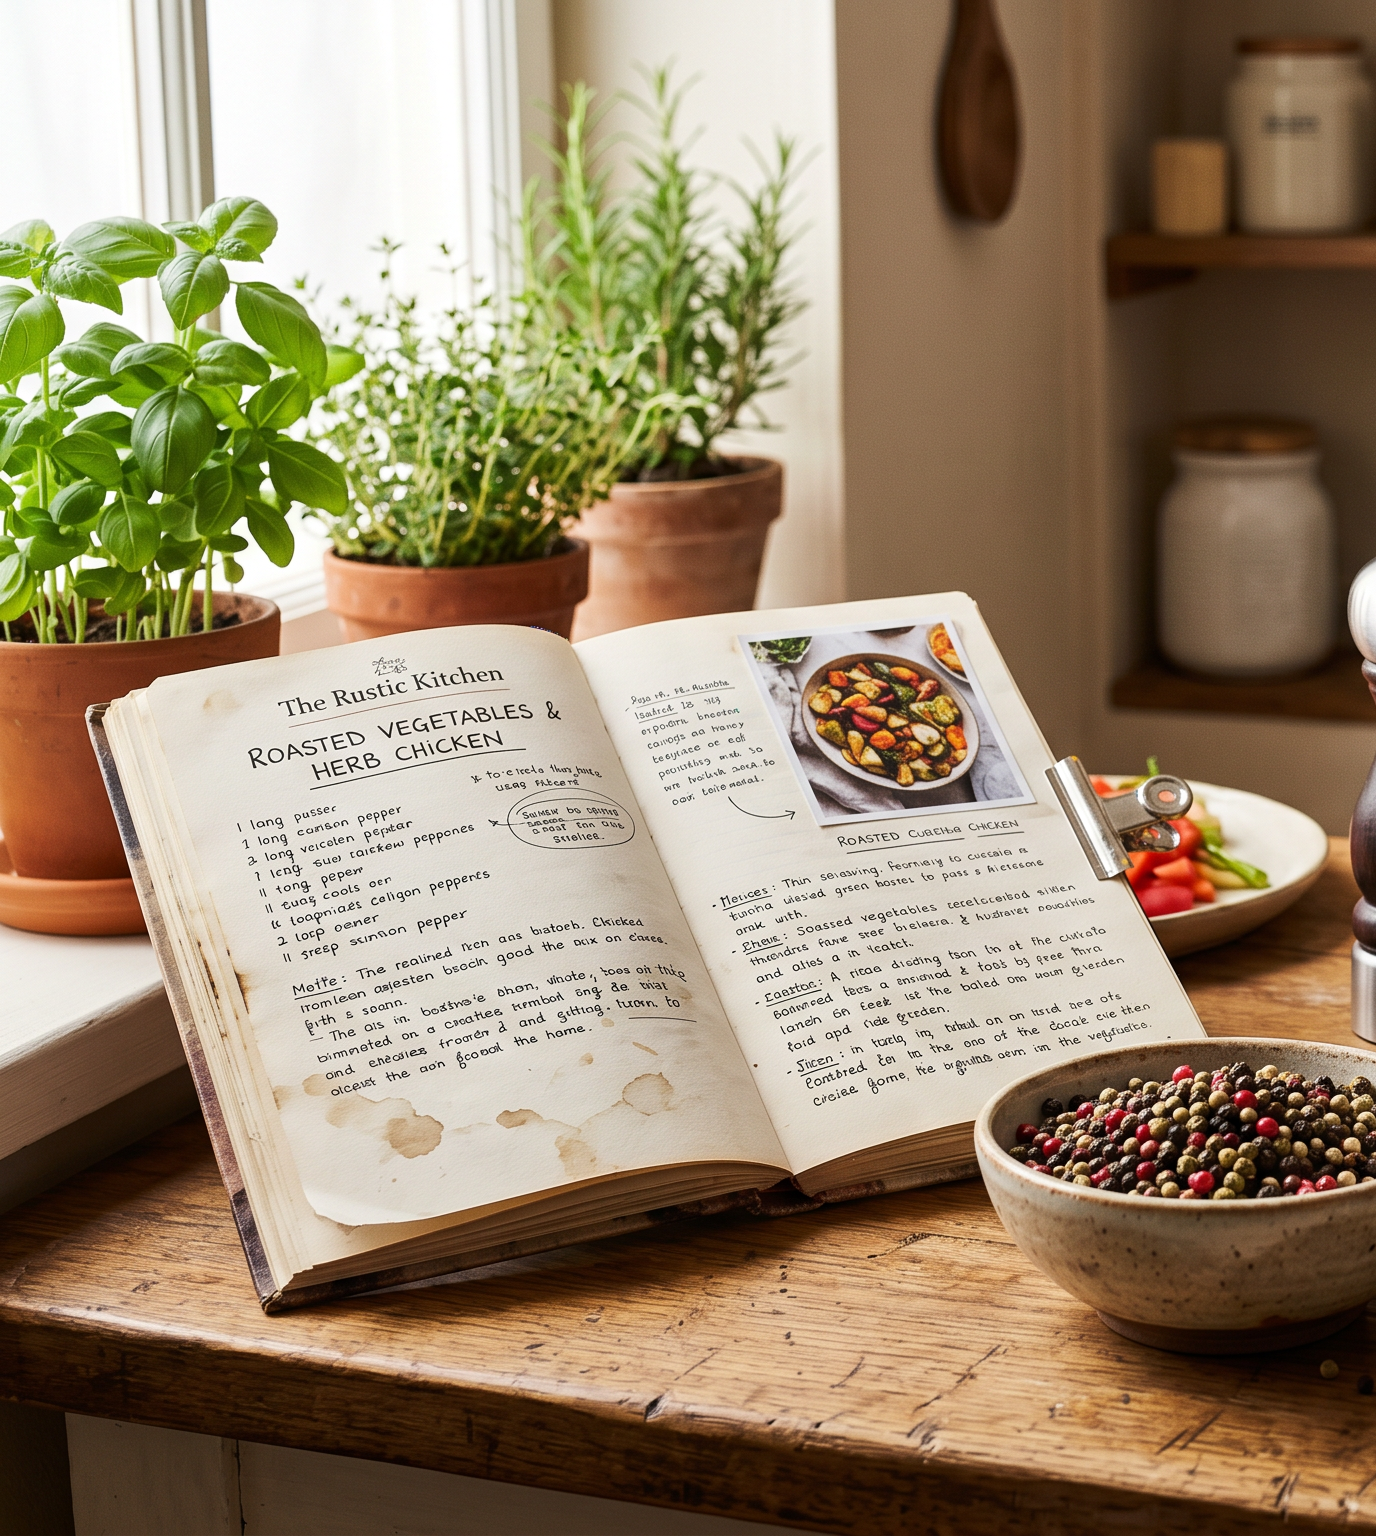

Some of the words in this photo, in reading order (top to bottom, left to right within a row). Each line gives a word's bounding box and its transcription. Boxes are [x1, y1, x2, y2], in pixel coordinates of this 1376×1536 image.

[277, 697, 328, 719] The
[330, 678, 409, 708] Rustic
[410, 666, 505, 692] Kitchen
[247, 730, 366, 770] ROASTED
[376, 703, 534, 739] VEGETABLES
[545, 700, 562, 721] &
[310, 752, 382, 781] HERB
[257, 833, 289, 847] long
[357, 806, 402, 828] pepper
[836, 831, 900, 848] ROASTED
[967, 819, 1020, 832] CHICKEN
[264, 849, 295, 865] long
[780, 877, 812, 889] Thin
[941, 869, 969, 883] pass
[416, 909, 468, 935] pepper
[774, 909, 808, 924] with.
[860, 904, 938, 924] vegetables
[496, 944, 535, 967] good
[541, 940, 565, 952] the
[756, 966, 785, 984] and
[959, 976, 1001, 992] baled
[518, 1011, 547, 1028] and
[664, 995, 681, 1008] to
[328, 1028, 357, 1042] The
[1057, 1036, 1082, 1048] the
[385, 1070, 411, 1083] the
[513, 1035, 539, 1047] the
